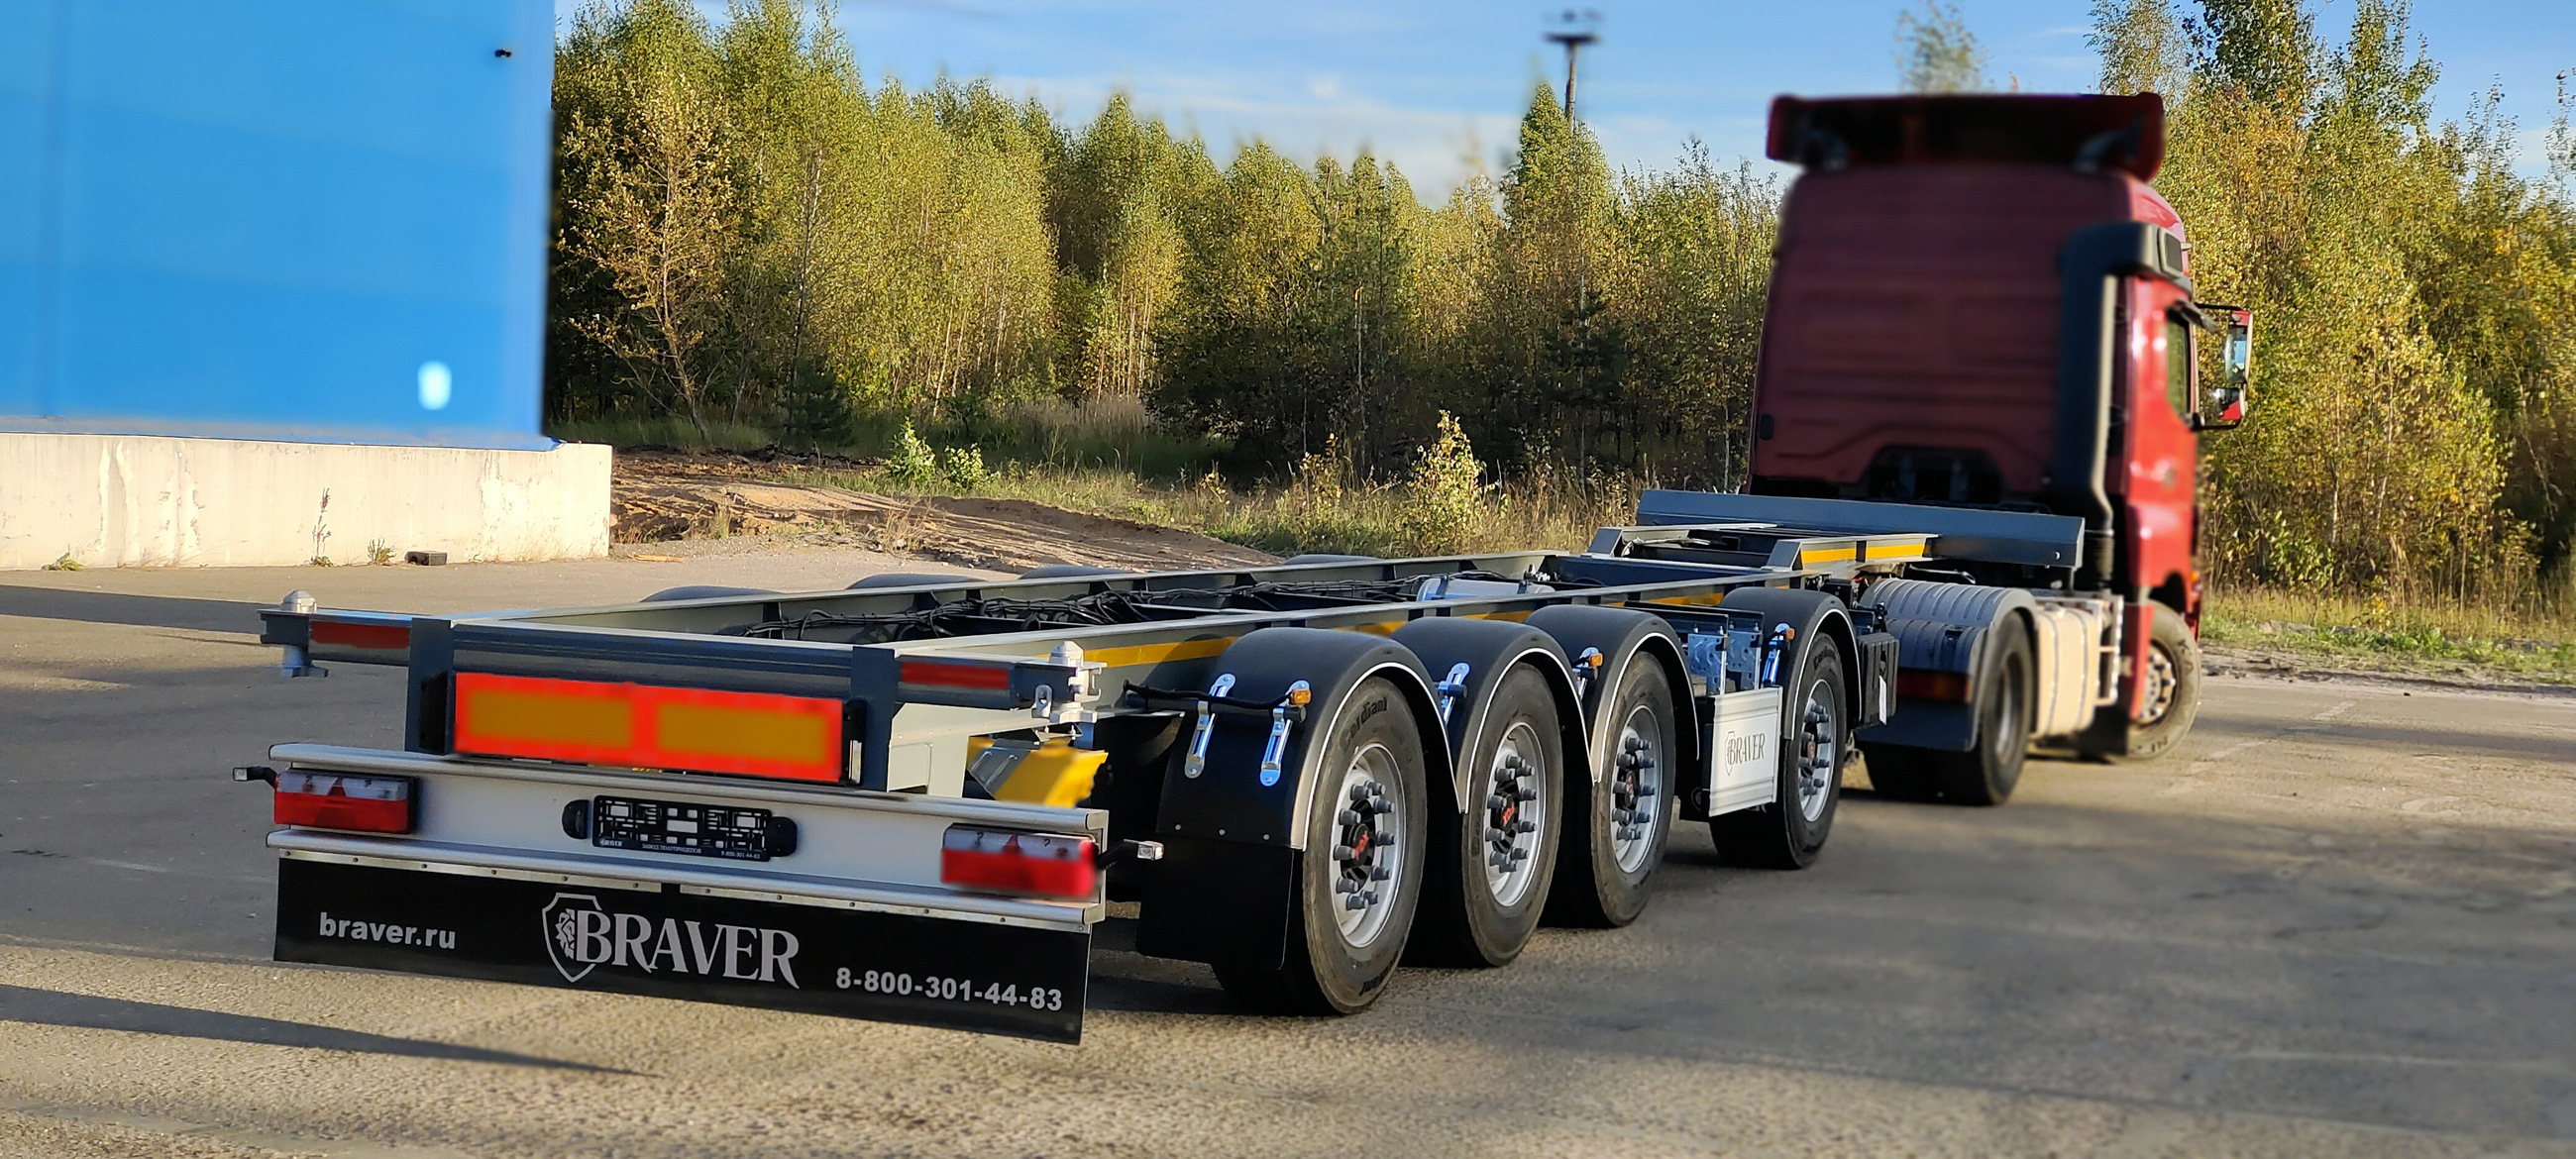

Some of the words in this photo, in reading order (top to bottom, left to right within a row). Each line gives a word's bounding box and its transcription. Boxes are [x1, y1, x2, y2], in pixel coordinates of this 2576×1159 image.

[1729, 732, 1766, 766] BRAVER
[319, 911, 456, 950] braver.ru
[576, 908, 800, 990] BRAVER
[835, 967, 1062, 1011] 8-800-301-44-83
